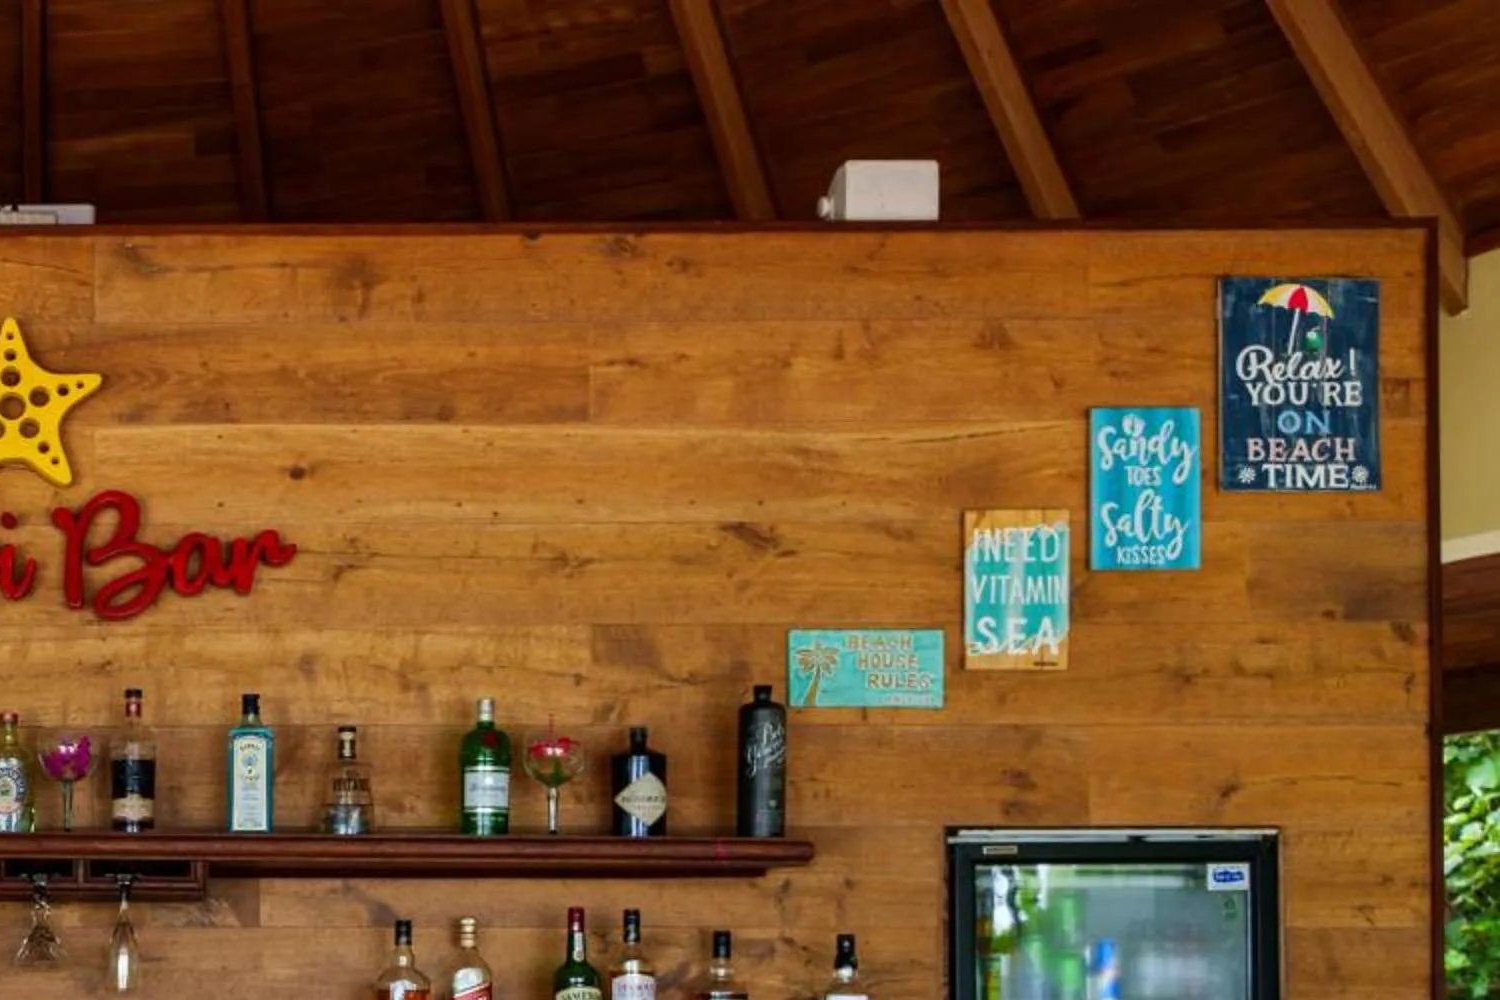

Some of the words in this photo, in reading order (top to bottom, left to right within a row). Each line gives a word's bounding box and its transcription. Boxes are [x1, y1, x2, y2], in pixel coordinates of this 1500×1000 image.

[1235, 344, 1357, 384] Relax!
[1245, 381, 1363, 407] YOU'RE
[1277, 409, 1332, 435] ON
[1097, 419, 1198, 485] Sandy
[1246, 437, 1357, 463] BEACH
[1123, 465, 1163, 487] TOES
[1261, 463, 1349, 489] TIME
[1100, 488, 1189, 561] Salty
[52, 489, 297, 622] Bar
[1116, 545, 1166, 566] KISSES
[969, 575, 1068, 605] VITAMIN
[976, 615, 1060, 656] SEA
[857, 652, 920, 670] HOUSE
[867, 671, 933, 689] RULES
